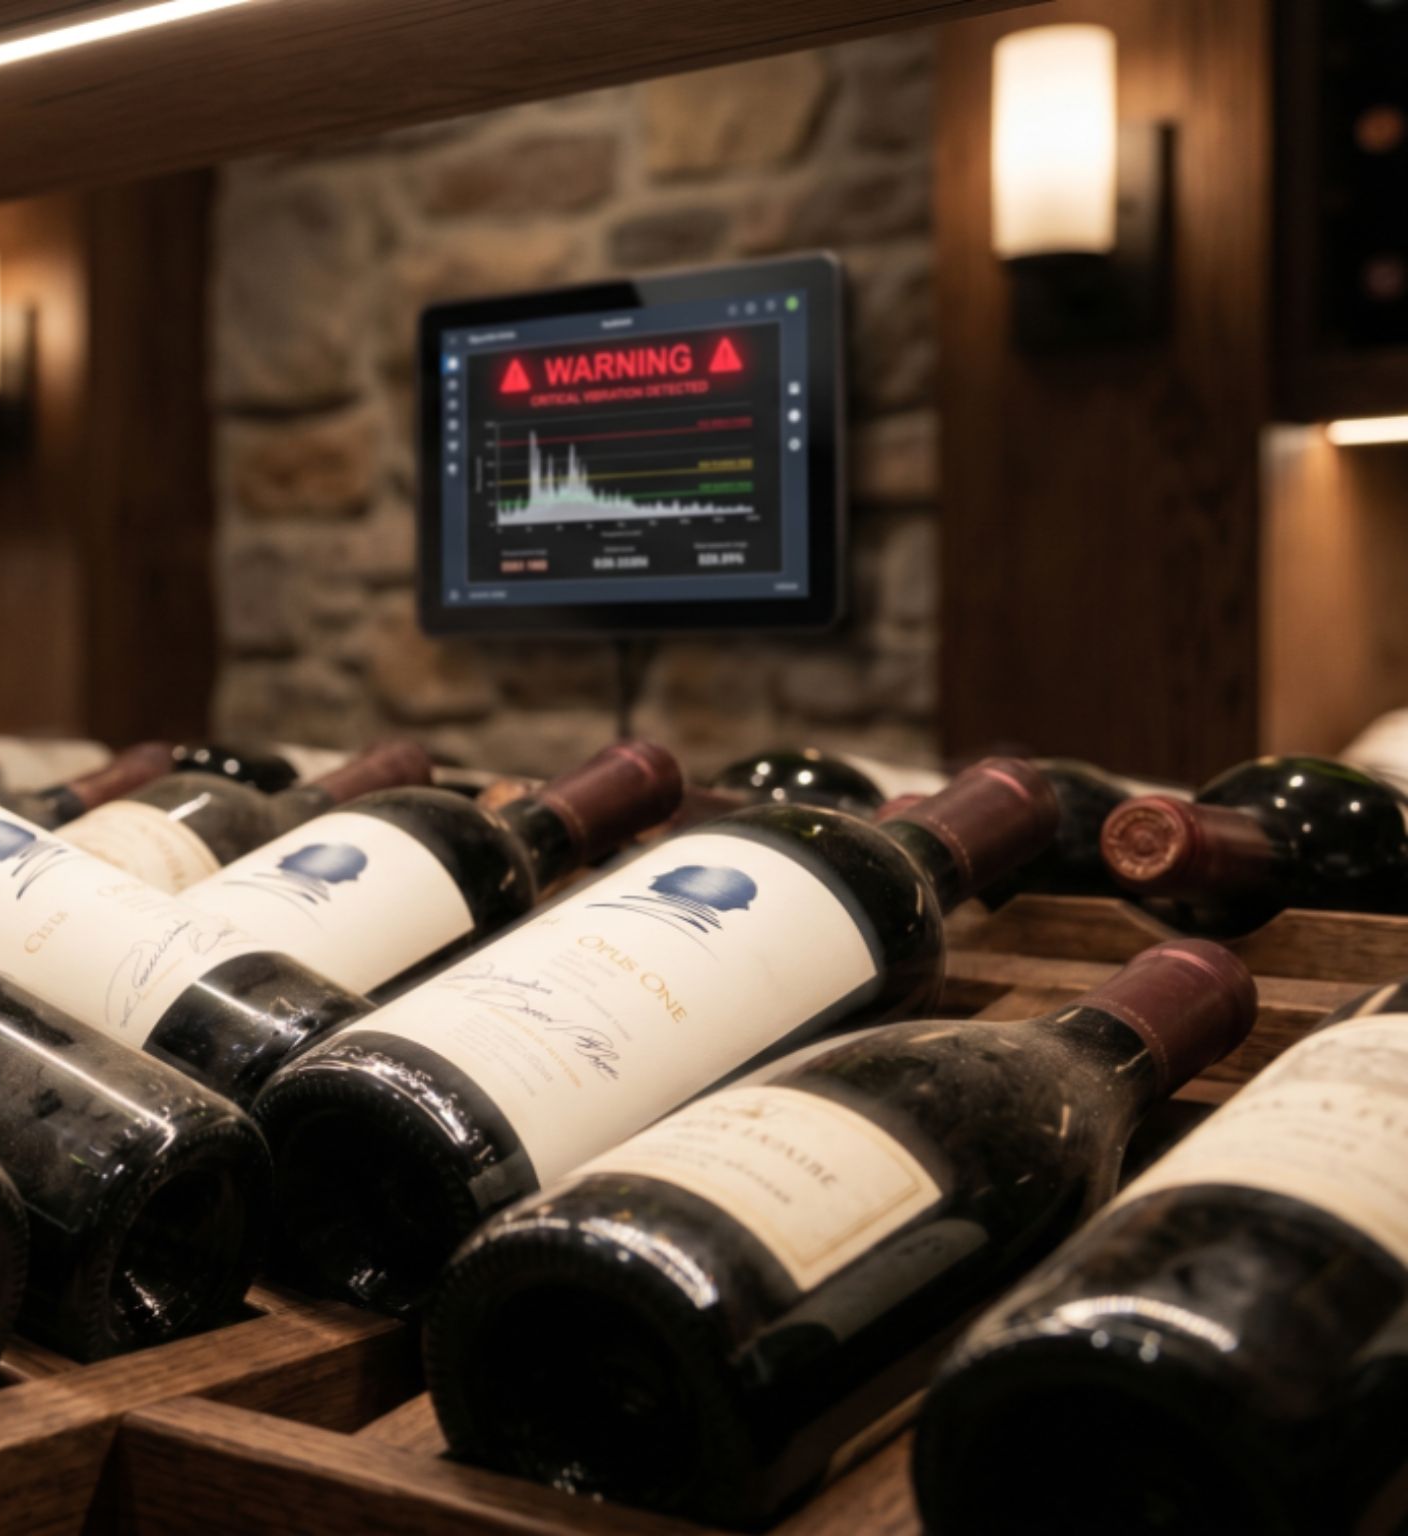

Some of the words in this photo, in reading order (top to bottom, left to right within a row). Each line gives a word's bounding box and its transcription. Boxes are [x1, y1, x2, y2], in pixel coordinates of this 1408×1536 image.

[544, 343, 692, 386] WARNING
[530, 393, 581, 408] CRITICAL
[583, 387, 643, 404] VIBRATION
[645, 380, 709, 397] DETECTED
